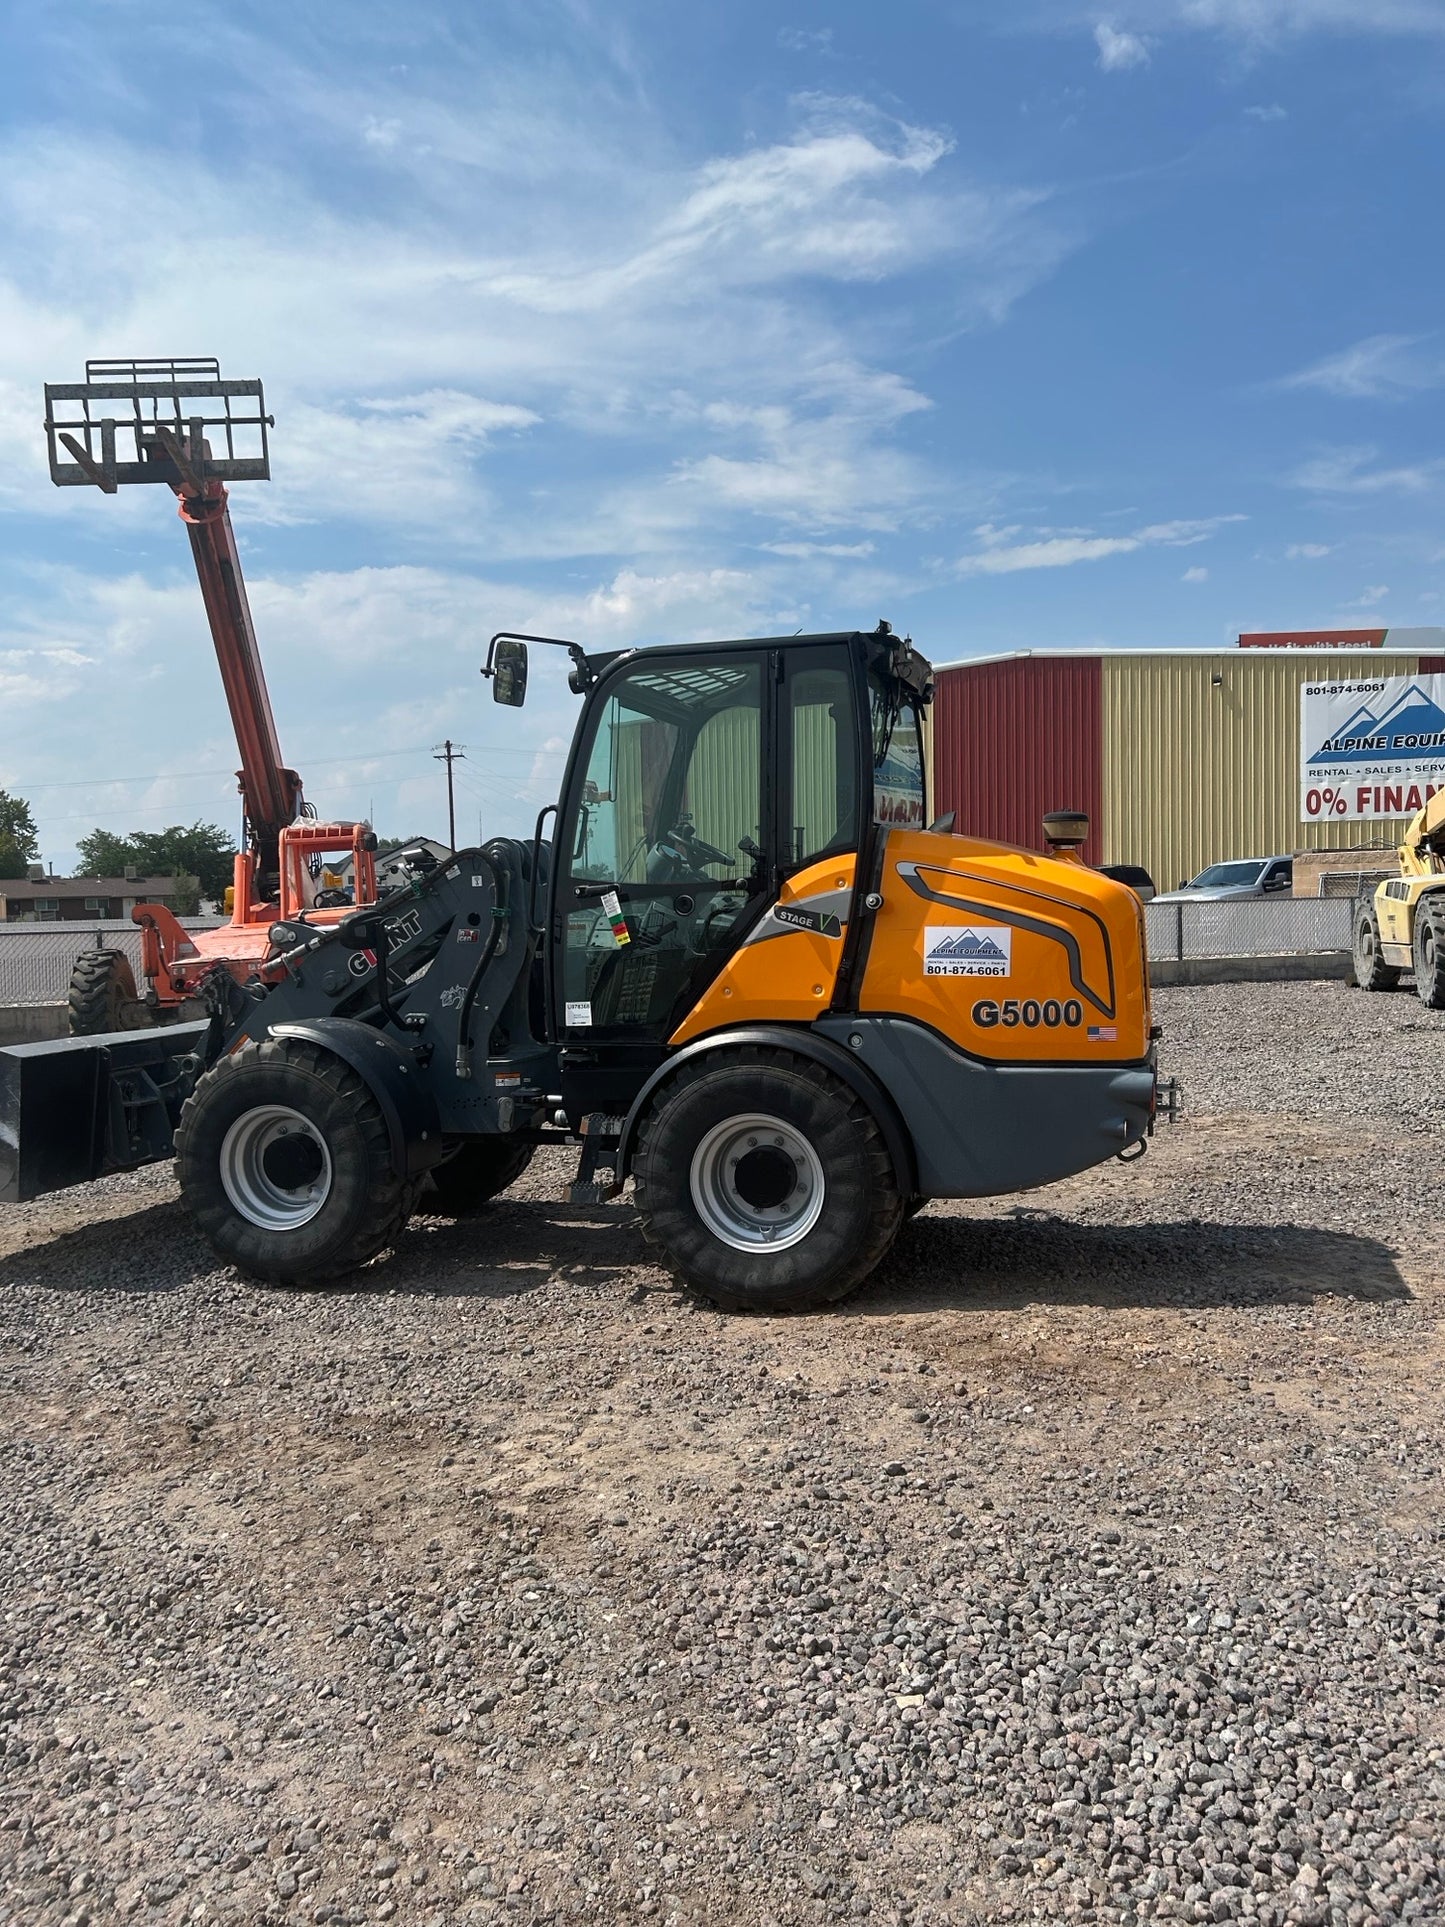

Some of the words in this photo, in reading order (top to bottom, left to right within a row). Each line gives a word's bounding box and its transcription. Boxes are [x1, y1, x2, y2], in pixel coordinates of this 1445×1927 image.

[1306, 683, 1385, 695] 801-874-6061
[1320, 737, 1387, 751] ALPINE
[1309, 769, 1352, 777] RENTAL
[1365, 766, 1402, 775] SALES
[1306, 787, 1348, 815] 0%
[780, 911, 814, 927] STAGE
[347, 908, 423, 977] GINT
[927, 966, 1006, 976] 801-874-6061
[972, 999, 1083, 1028] G5000
